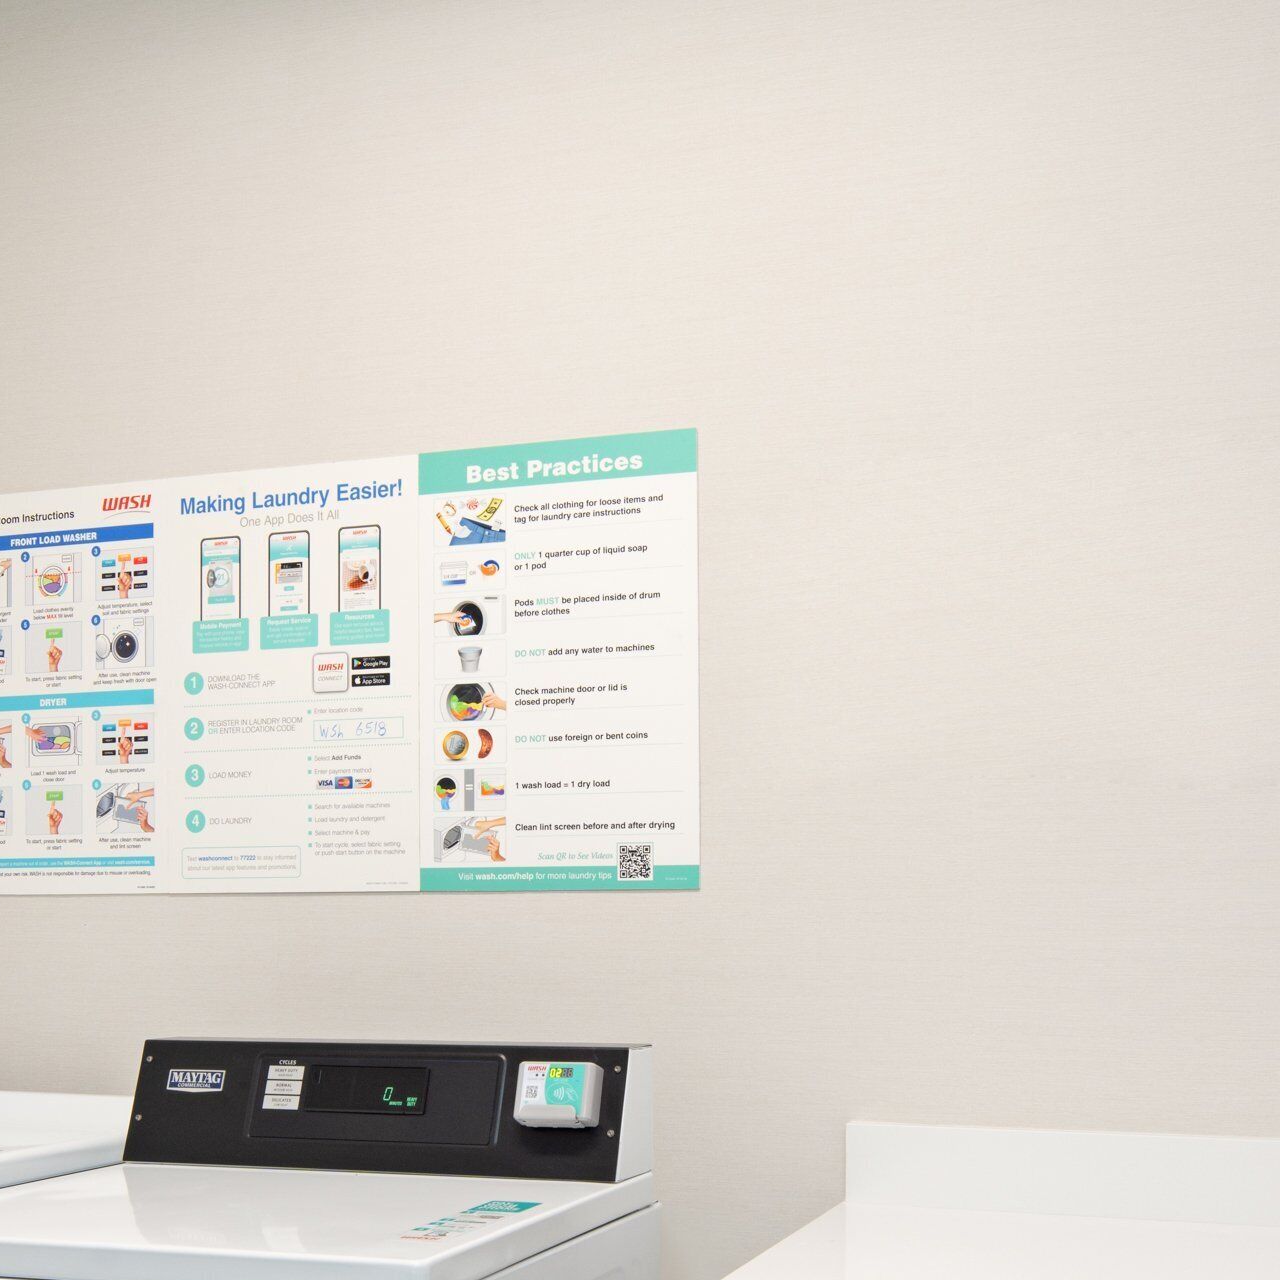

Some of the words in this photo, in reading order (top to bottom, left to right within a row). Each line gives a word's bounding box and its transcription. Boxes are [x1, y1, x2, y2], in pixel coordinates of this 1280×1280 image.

[466, 462, 519, 483] Best
[527, 454, 643, 478] Practices
[180, 495, 245, 514] Making
[253, 487, 329, 508] Laundry
[337, 479, 402, 501] Easier!
[102, 494, 152, 511] WASH
[514, 504, 538, 512] Check
[552, 501, 584, 509] clothing
[22, 511, 74, 522] Instructions
[240, 516, 260, 527] One
[264, 516, 284, 527] App
[288, 512, 313, 523] Does
[317, 511, 324, 520] It
[327, 510, 339, 520] All
[514, 516, 526, 524] tag
[542, 513, 571, 521] laundry
[593, 508, 641, 516] instructions
[10, 538, 38, 546] FRONT
[63, 532, 97, 541] WASHER
[545, 550, 573, 559] quarter
[603, 546, 625, 555] liquid
[532, 561, 546, 571] pod
[574, 595, 600, 604] placed
[208, 674, 246, 682] DOWNLOAD
[40, 697, 67, 707] DRYER
[543, 697, 575, 706] properly
[565, 734, 592, 742] foreign
[578, 780, 590, 789] dry
[649, 821, 675, 830] drying
[475, 873, 533, 881] wash.com/help
[569, 873, 597, 881] laundry
[598, 873, 612, 882] tips
[171, 1071, 221, 1083] MAYTAG
